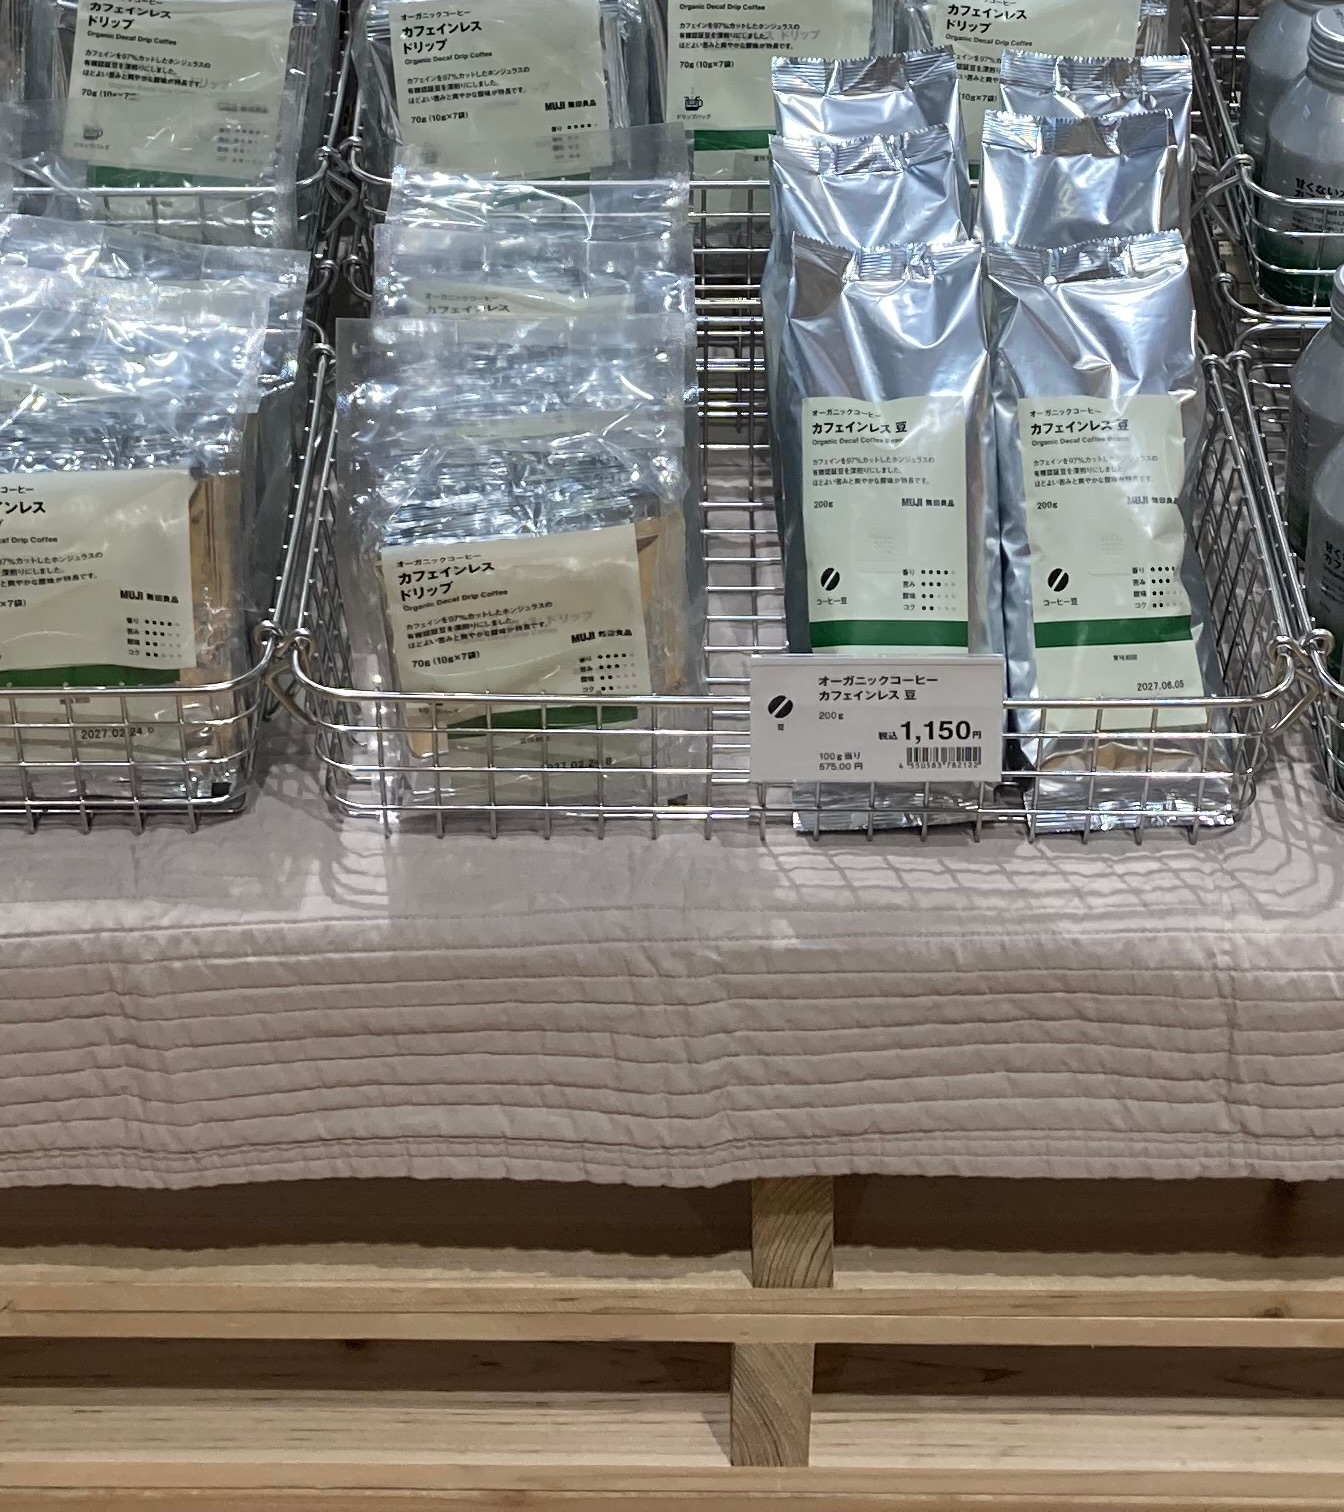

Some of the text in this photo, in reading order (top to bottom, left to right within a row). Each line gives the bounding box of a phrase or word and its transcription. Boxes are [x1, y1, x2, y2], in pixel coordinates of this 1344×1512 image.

[89, 1, 171, 19] カフェインレス
[947, 4, 1027, 20] カフェインレス
[88, 15, 134, 30] ドリップ
[402, 21, 482, 38] カフェインレス
[946, 19, 992, 34] ドリップ
[403, 39, 448, 55] ドリップ
[812, 409, 881, 419] オーガニックコーヒー
[812, 421, 907, 435] カフェインレス 豆
[1030, 419, 1129, 436] カフェインレス 豆
[398, 561, 495, 586] カフェインレス
[400, 581, 454, 601] ドリップ
[817, 597, 847, 606] コーヒー豆
[818, 675, 938, 686] オーガニックコーヒー
[819, 690, 916, 701] カフェインレス 豆
[819, 712, 844, 720] 200g
